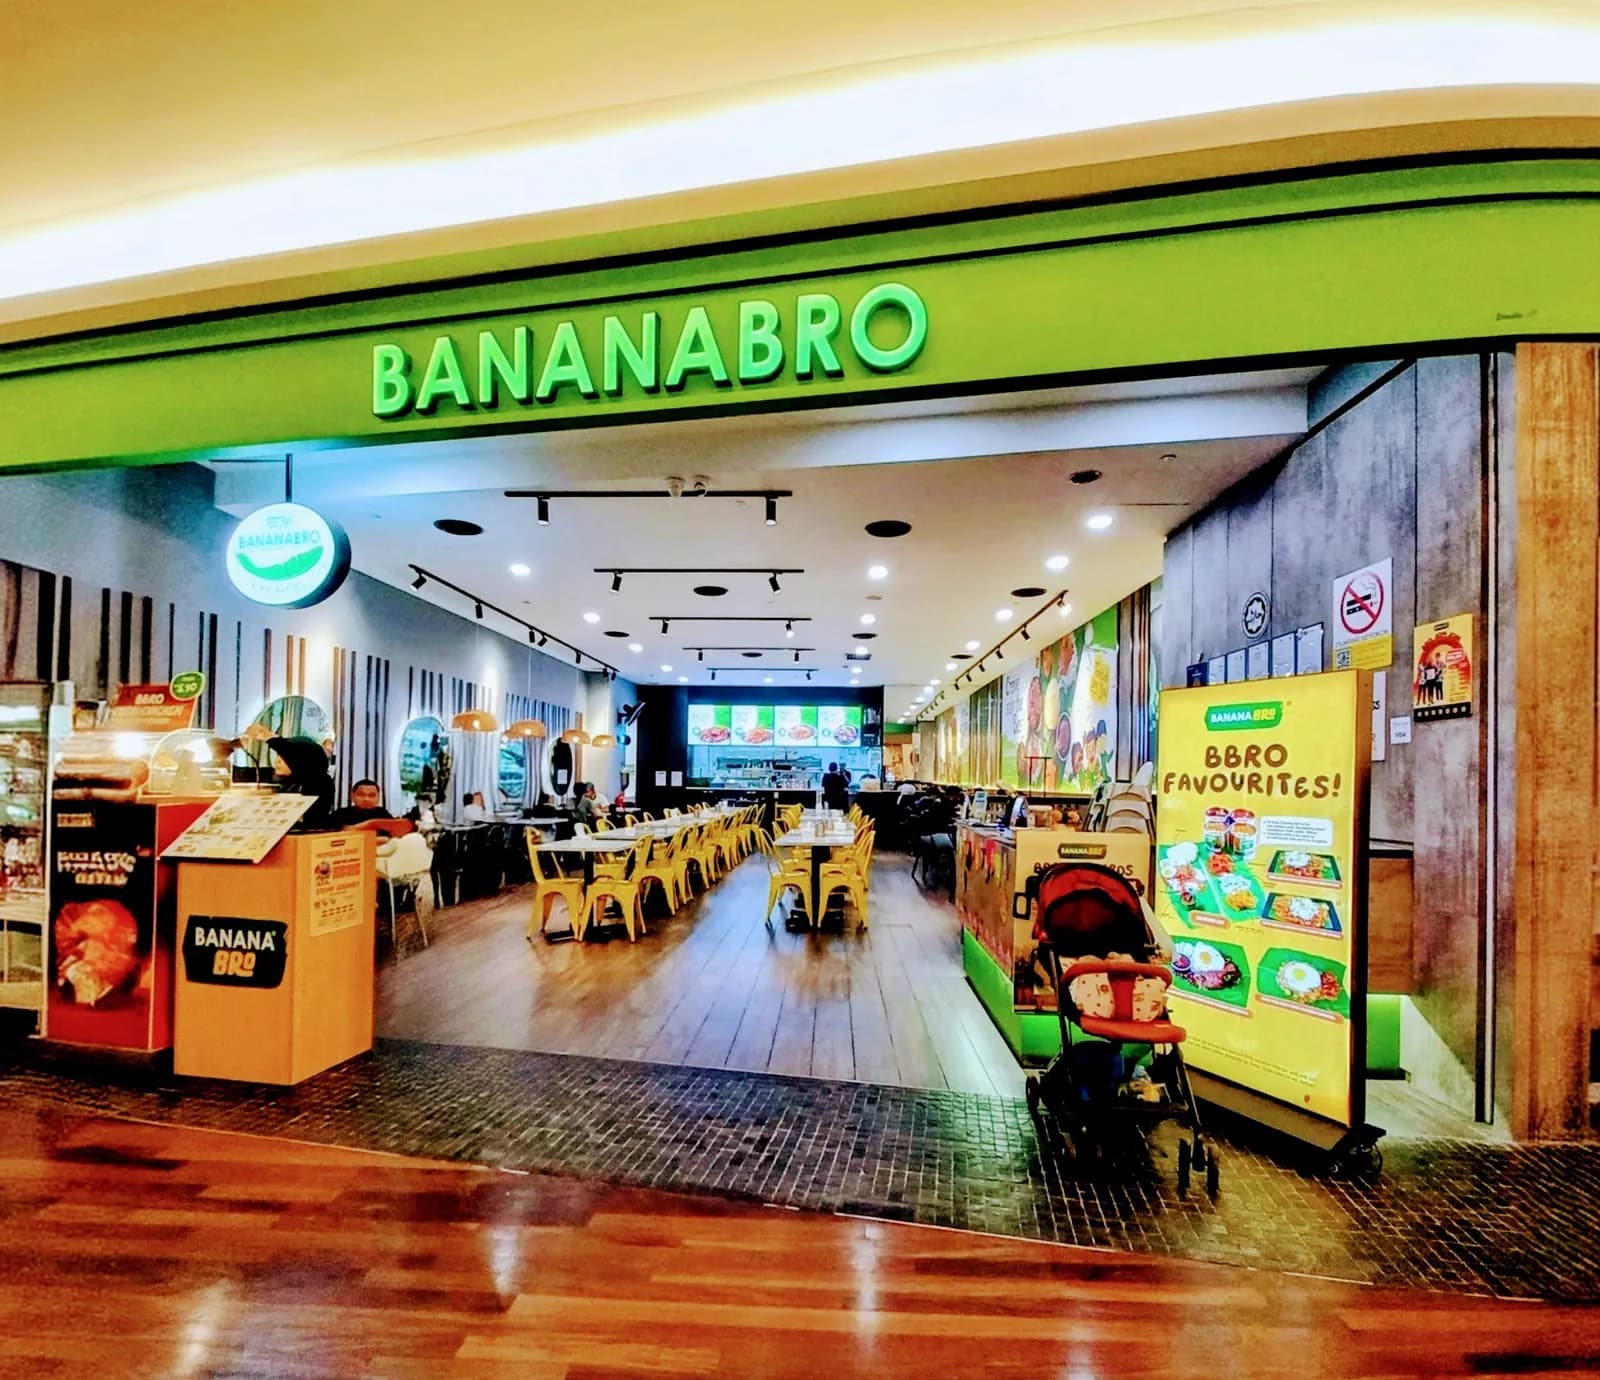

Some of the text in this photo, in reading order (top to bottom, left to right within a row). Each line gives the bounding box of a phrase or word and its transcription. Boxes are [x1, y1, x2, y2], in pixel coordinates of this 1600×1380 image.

[372, 282, 929, 418] BANANABRO
[238, 530, 321, 549] BANANABRO
[1211, 708, 1276, 723] BANANA BRO
[1204, 743, 1289, 769] BBRO
[1163, 772, 1342, 799] FAVOURITES!
[1060, 847, 1088, 855] BANANA
[194, 926, 275, 951] BANANA
[212, 950, 257, 977] BRO
